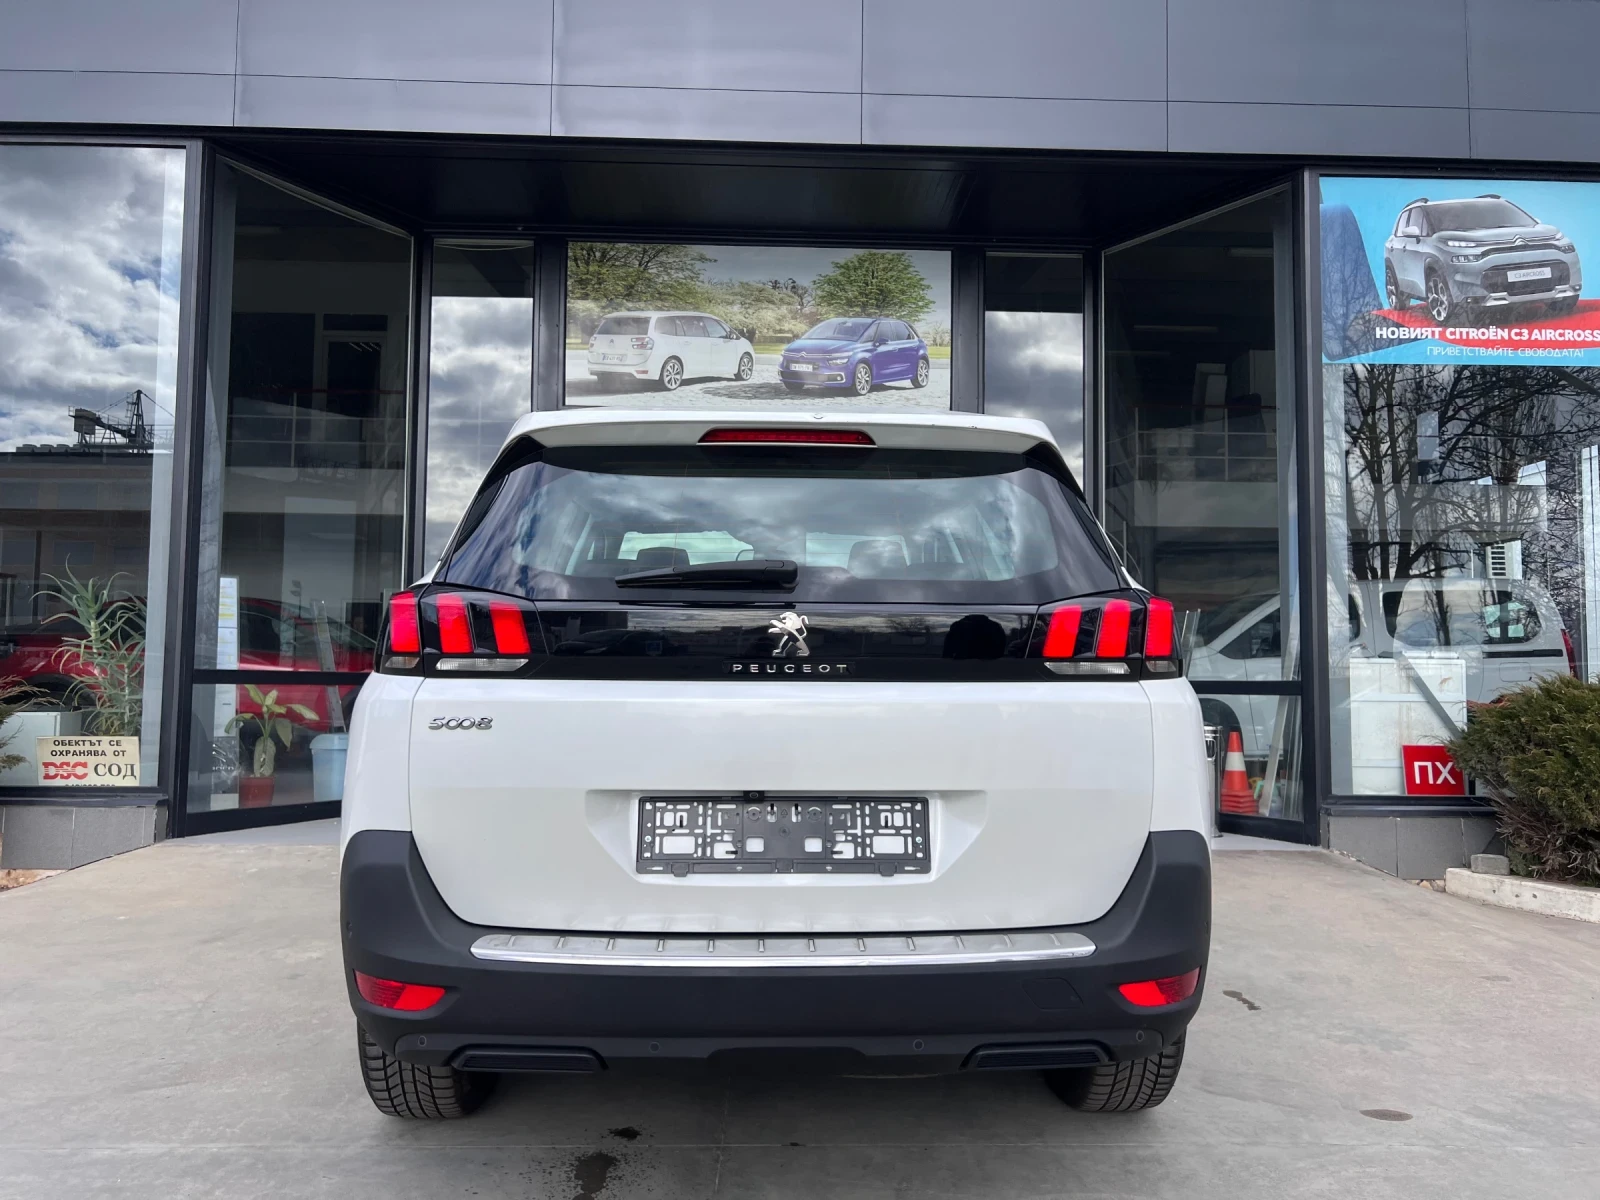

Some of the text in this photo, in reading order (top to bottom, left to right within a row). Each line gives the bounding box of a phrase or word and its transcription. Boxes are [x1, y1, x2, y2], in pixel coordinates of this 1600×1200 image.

[1375, 326, 1600, 341] НОВИЯТ CITROËN C3 AIRCROSS
[1427, 345, 1584, 358] ПРИВЕТСТВАЙТЕ СВОБОДАТА!
[732, 664, 847, 673] PEUGEOT
[428, 716, 493, 731] 5008
[50, 749, 127, 757] ОХРАНЯВА ОТ
[42, 761, 137, 780] DSC СОД
[1413, 761, 1457, 785] ПХ
